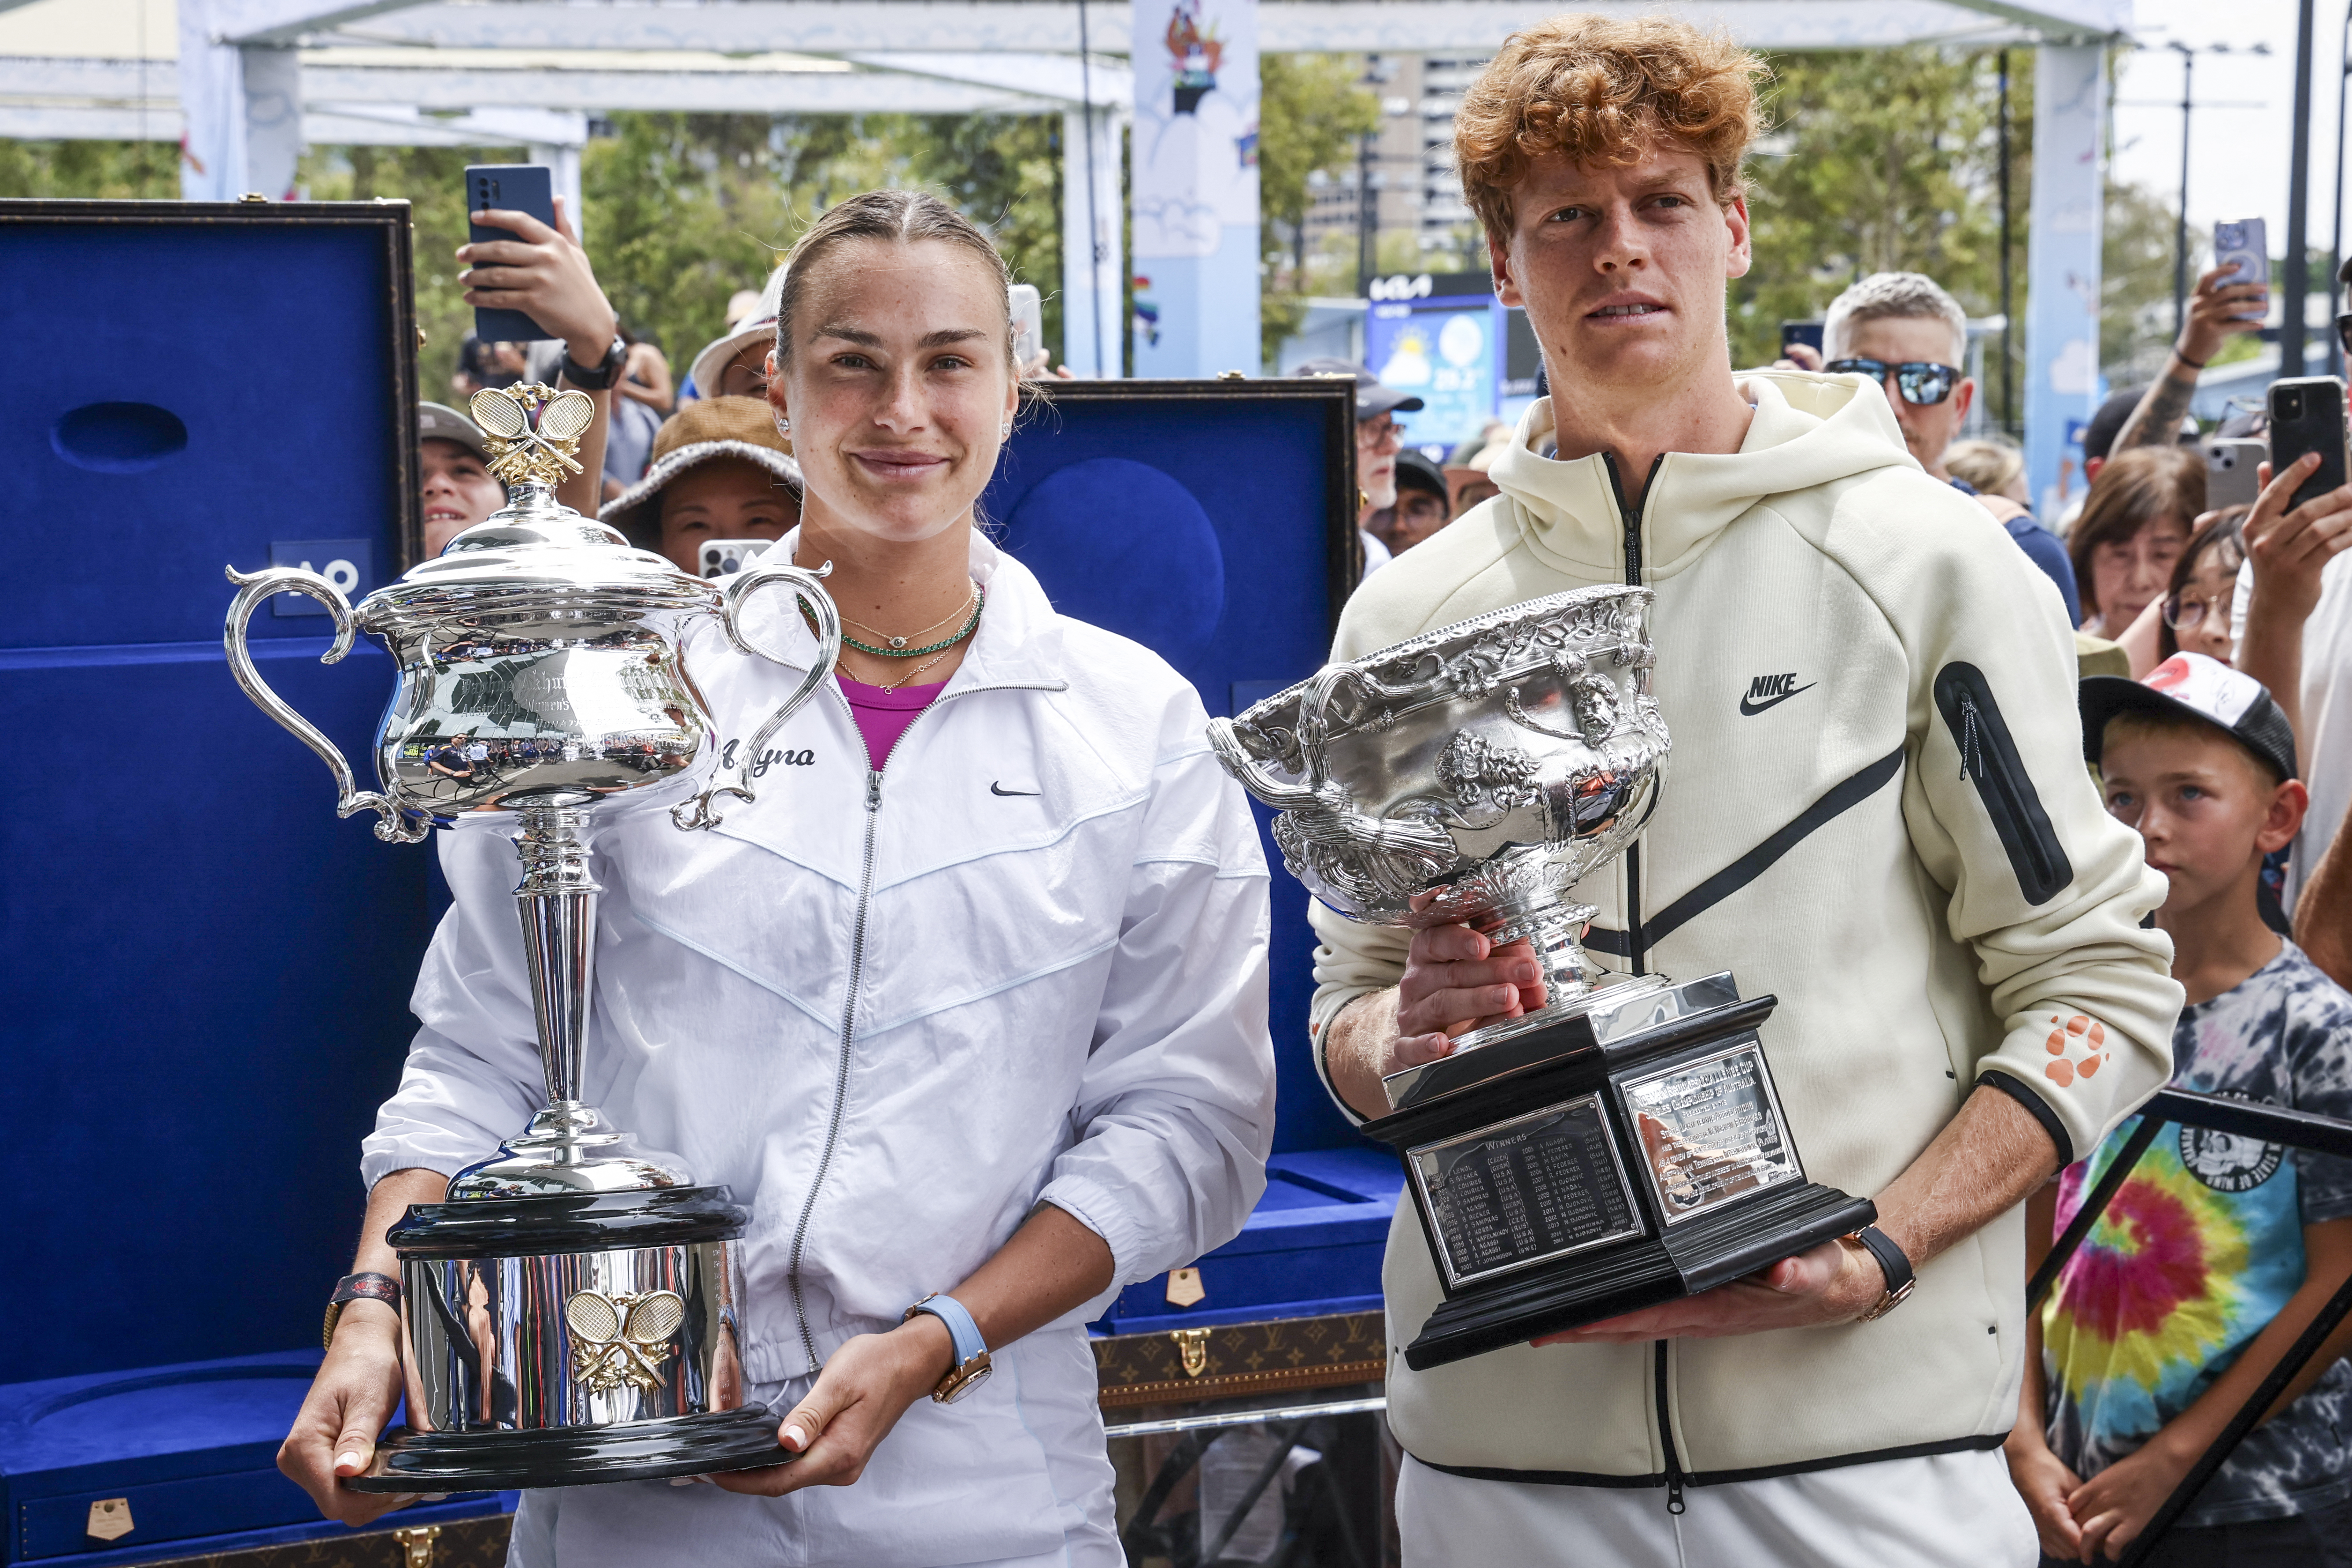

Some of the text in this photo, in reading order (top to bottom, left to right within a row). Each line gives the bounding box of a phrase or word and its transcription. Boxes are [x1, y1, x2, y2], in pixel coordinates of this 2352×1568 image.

[1749, 673, 1797, 698] NIKE
[722, 738, 815, 778] Ayna
[1698, 1065, 1741, 1087] CHALLENGE
[1739, 1060, 1754, 1074] CUP
[1644, 1076, 1756, 1120] SINGLES CHAMPIONSHIP OF AUSTRALIA.
[1682, 1104, 1710, 1119] PRESENTED
[1661, 1103, 1754, 1139] STATE LAWN TENNIS ASSOCIATIONS
[1484, 1134, 1527, 1150] WINNERS
[1545, 1138, 1566, 1147] AGASSI
[1547, 1144, 1572, 1154] FEDERER
[1584, 1135, 1599, 1144] (SUI)
[1661, 1143, 1672, 1152] AND
[1672, 1140, 1682, 1148] THE
[1682, 1133, 1702, 1145] FRIENDS
[1550, 1153, 1568, 1161] SAFIN
[1586, 1142, 1602, 1152] (RUS)
[1553, 1158, 1578, 1169] FEDERER
[1589, 1150, 1605, 1159] (SUI)
[1658, 1133, 1778, 1182] AUSTRALIAN INTERNATIONAL PLAYER
[1670, 1152, 1686, 1163] TOKEN
[1453, 1165, 1472, 1174] LENDL
[1487, 1154, 1509, 1165] (CZECH)
[1455, 1172, 1478, 1181] BECKER
[1490, 1161, 1510, 1172] (GERM)
[1555, 1166, 1580, 1176] FEDERER
[1592, 1158, 1608, 1167] (SUI)
[1457, 1179, 1482, 1189] COURIER
[1558, 1174, 1584, 1184] DJOKOVIC
[1594, 1166, 1611, 1175] (SRB)
[1561, 1183, 1582, 1192] NADAL
[1597, 1174, 1613, 1183] (ESP)
[1460, 1186, 1484, 1196] COURIER
[1462, 1193, 1489, 1204] SAMPRAS
[1563, 1189, 1589, 1200] FEDERER
[1600, 1182, 1616, 1191] (SUI)
[1565, 1197, 1593, 1208] DJOKOVIC
[1602, 1189, 1619, 1198] (SRB)
[1466, 1202, 1487, 1212] AGASSI
[1468, 1210, 1490, 1220] BECKER
[1502, 1199, 1524, 1210] (GERM)
[1568, 1204, 1595, 1215] DJOKOVIC
[1604, 1197, 1622, 1206] (SRB)
[1570, 1212, 1598, 1223] DJOKOVIC
[1606, 1204, 1625, 1213] (SRB)
[1471, 1215, 1499, 1227] SAMPRAS
[1474, 1225, 1493, 1234] KORDA
[1508, 1214, 1527, 1225] (CZE)
[1573, 1220, 1605, 1231] WAWRINKA
[1575, 1227, 1602, 1237] DJOKOVIC
[1612, 1219, 1628, 1227] (SRB)
[1476, 1229, 1509, 1242] KAFELNIKOV
[1511, 1222, 1529, 1232] (RUS)
[1479, 1239, 1499, 1249] AGASSI
[1481, 1247, 1501, 1256] AGASSI
[1483, 1252, 1513, 1263] JOHANSSON
[1518, 1244, 1537, 1254] (SWE)
[719, 1352, 727, 1361] 1991
